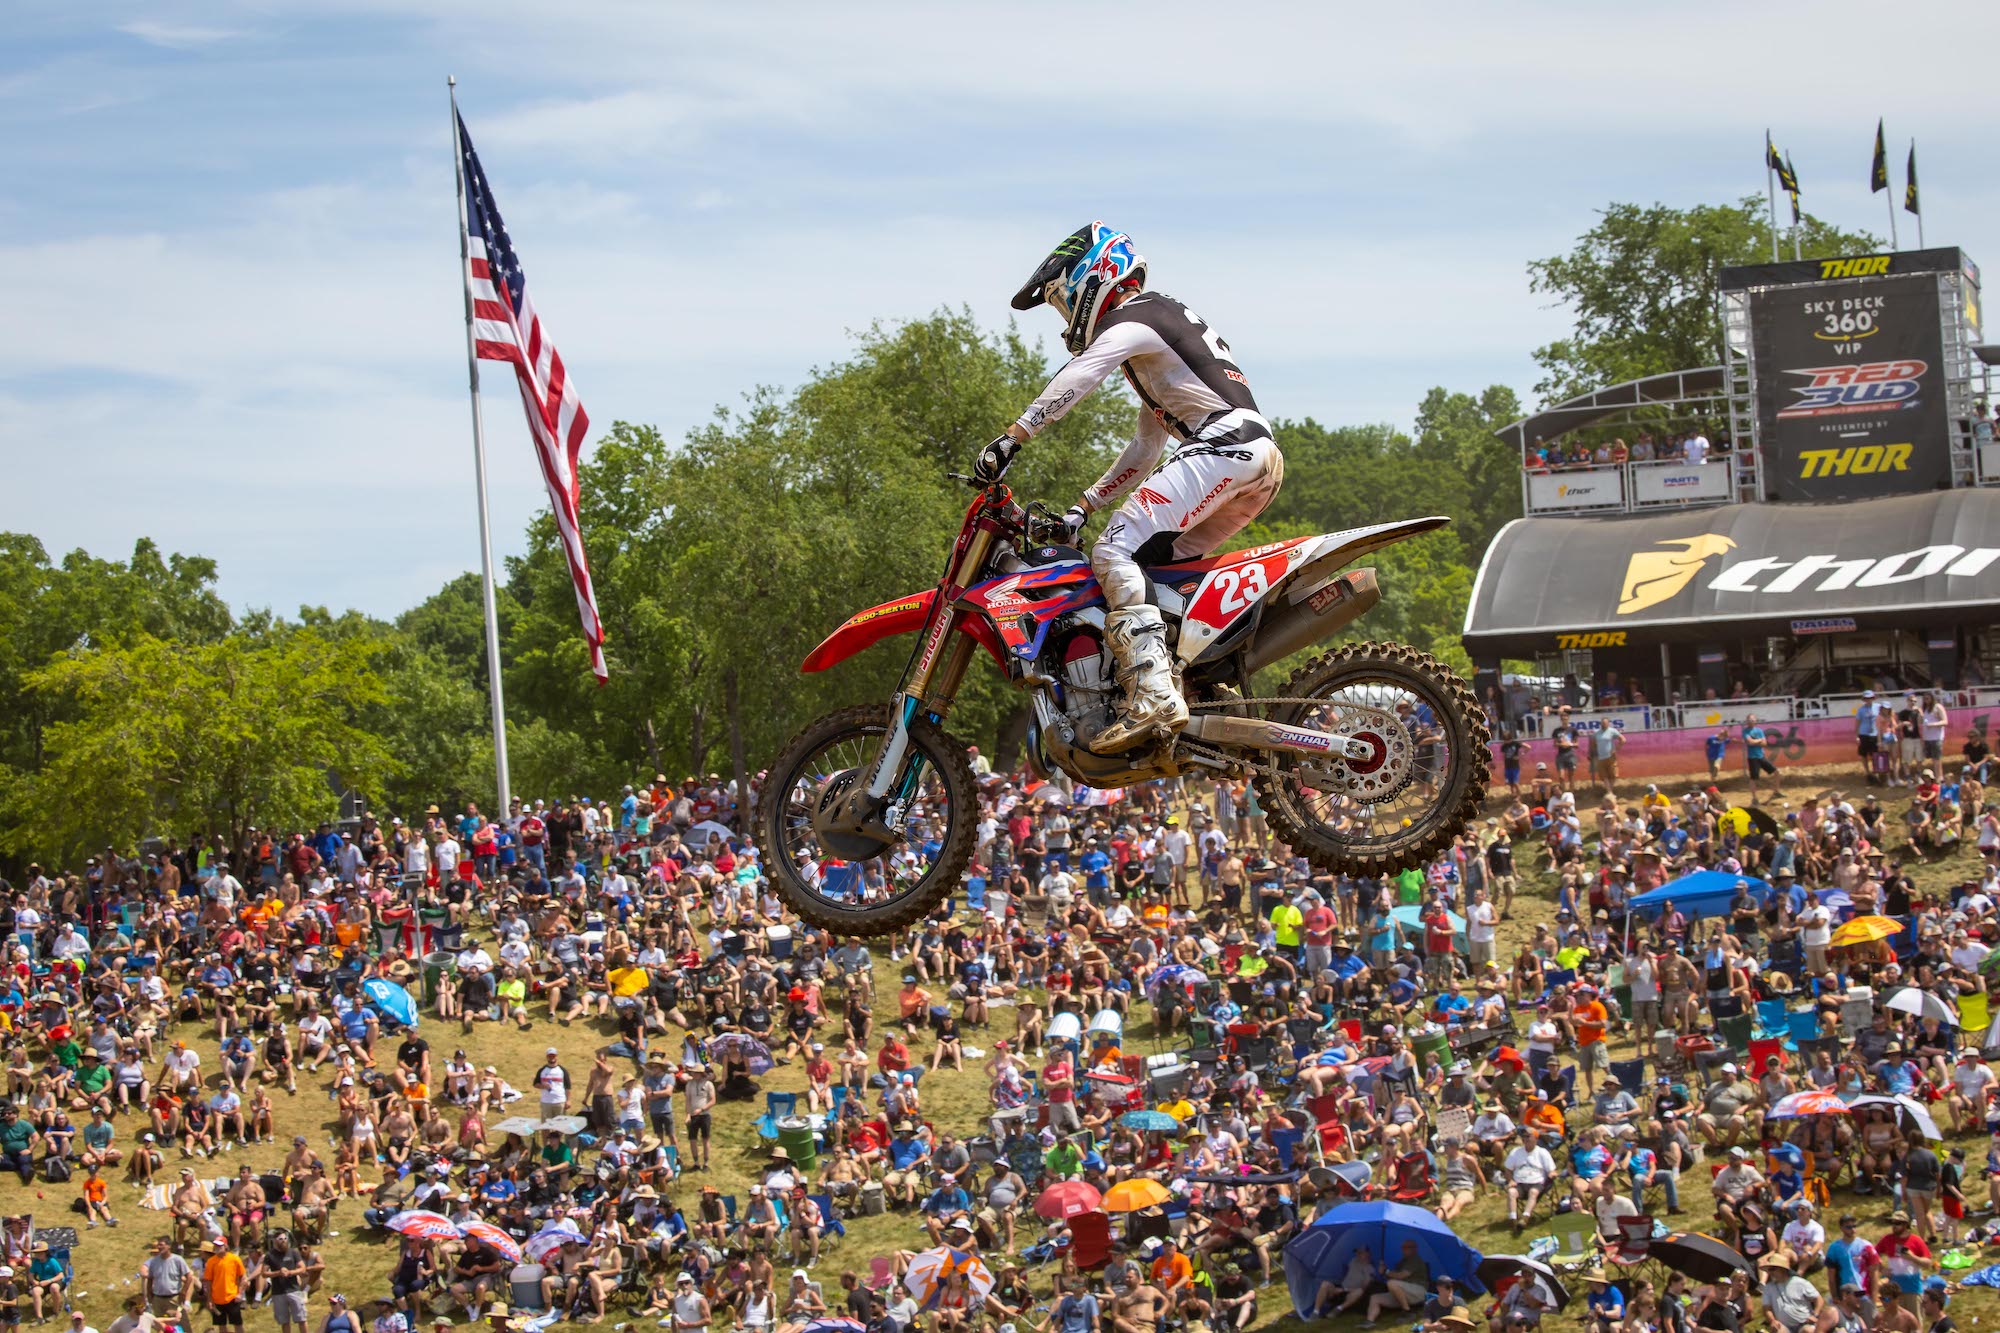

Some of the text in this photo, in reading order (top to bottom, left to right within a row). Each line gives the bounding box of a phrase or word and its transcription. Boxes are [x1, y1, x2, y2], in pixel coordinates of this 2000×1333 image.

[1820, 256, 1890, 279] THOR
[1804, 296, 1885, 314] SKY DECK
[1833, 342, 1862, 355] VIP
[1788, 360, 1928, 388] RED
[1790, 380, 1920, 409] BUD
[1820, 422, 1873, 432] PRESENTED
[1798, 443, 1913, 478] THOR
[1098, 467, 1138, 497] ONDA
[1132, 493, 1153, 518] HONDA
[1191, 477, 1233, 517] HONDA
[1250, 542, 1285, 558] USA
[1214, 563, 1268, 615] 23
[850, 602, 921, 625] 1-800-SEXTON
[986, 598, 1029, 609] HONDA
[918, 614, 948, 672] SHOWA
[1556, 631, 1627, 649] THOR
